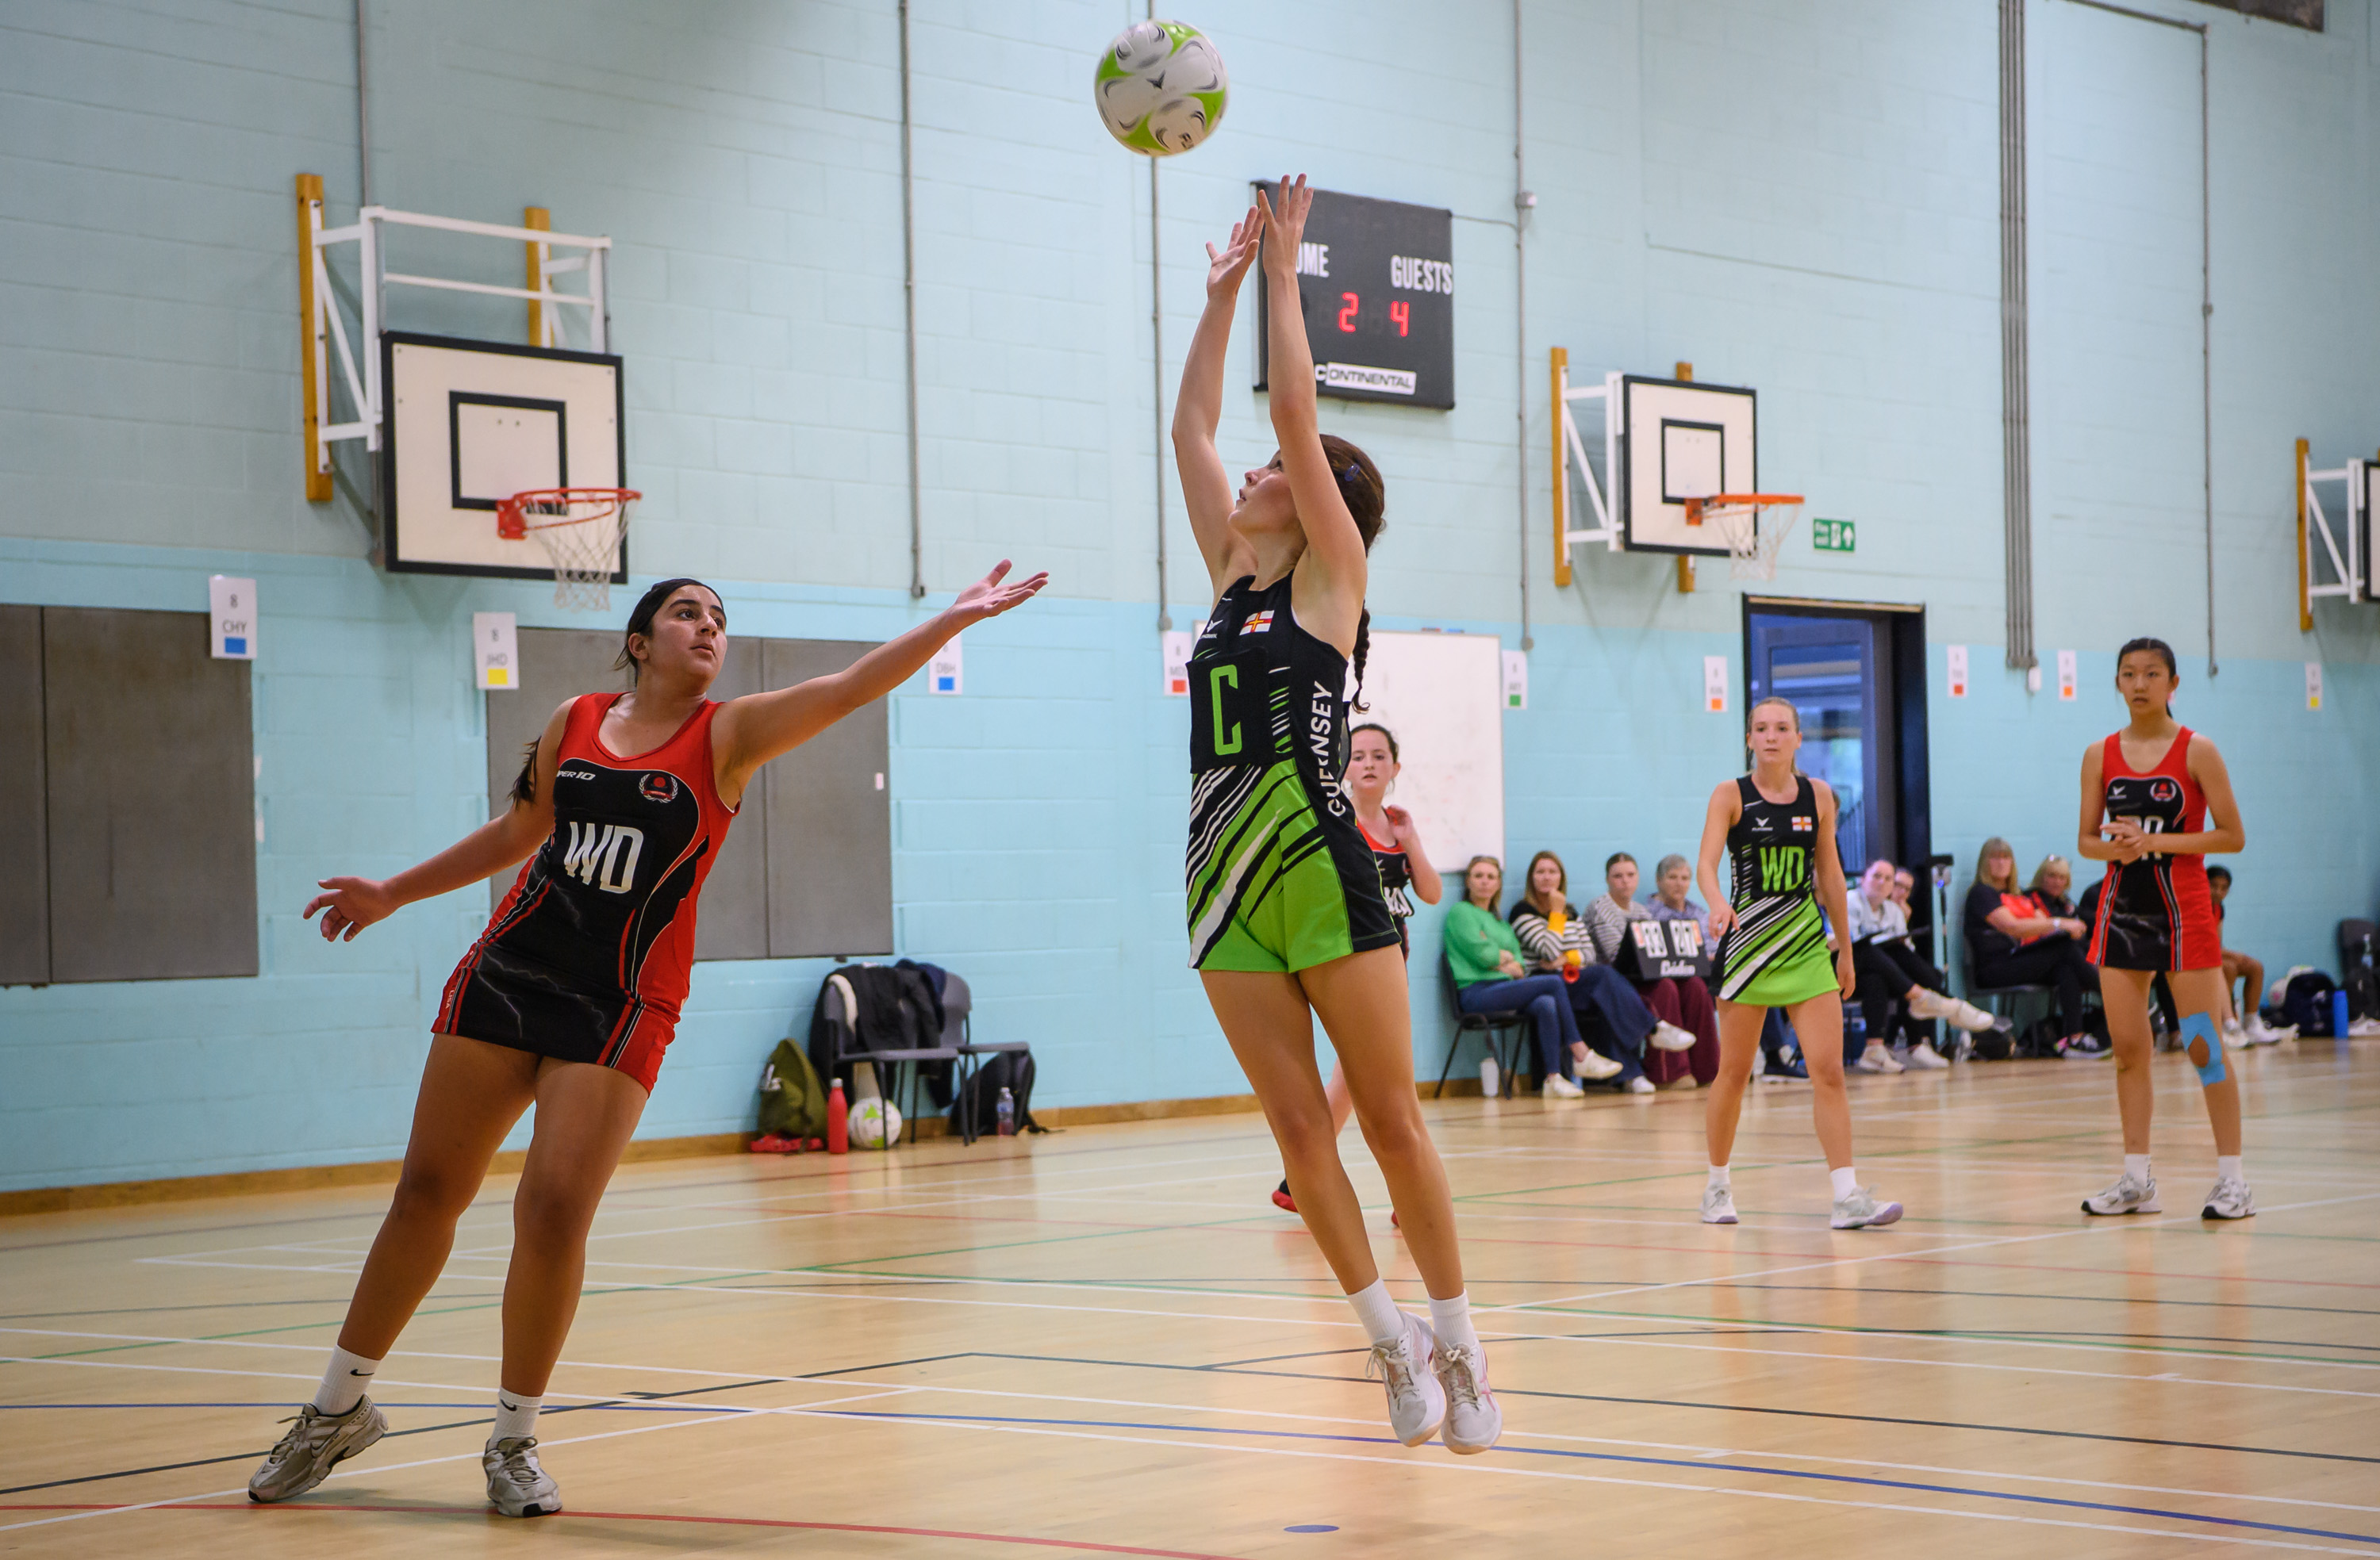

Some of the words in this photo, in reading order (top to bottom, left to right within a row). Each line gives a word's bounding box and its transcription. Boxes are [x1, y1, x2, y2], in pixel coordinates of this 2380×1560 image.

[1391, 255, 1453, 295] GUESTS
[1339, 292, 1359, 332] 2
[1391, 301, 1410, 337] 4
[1315, 364, 1411, 389] CONTINENTAL
[230, 593, 238, 608] 8
[223, 619, 248, 634] CHY
[1210, 664, 1242, 756] C
[576, 771, 596, 781] 10
[564, 821, 644, 895] WD
[1760, 845, 1805, 892] WD
